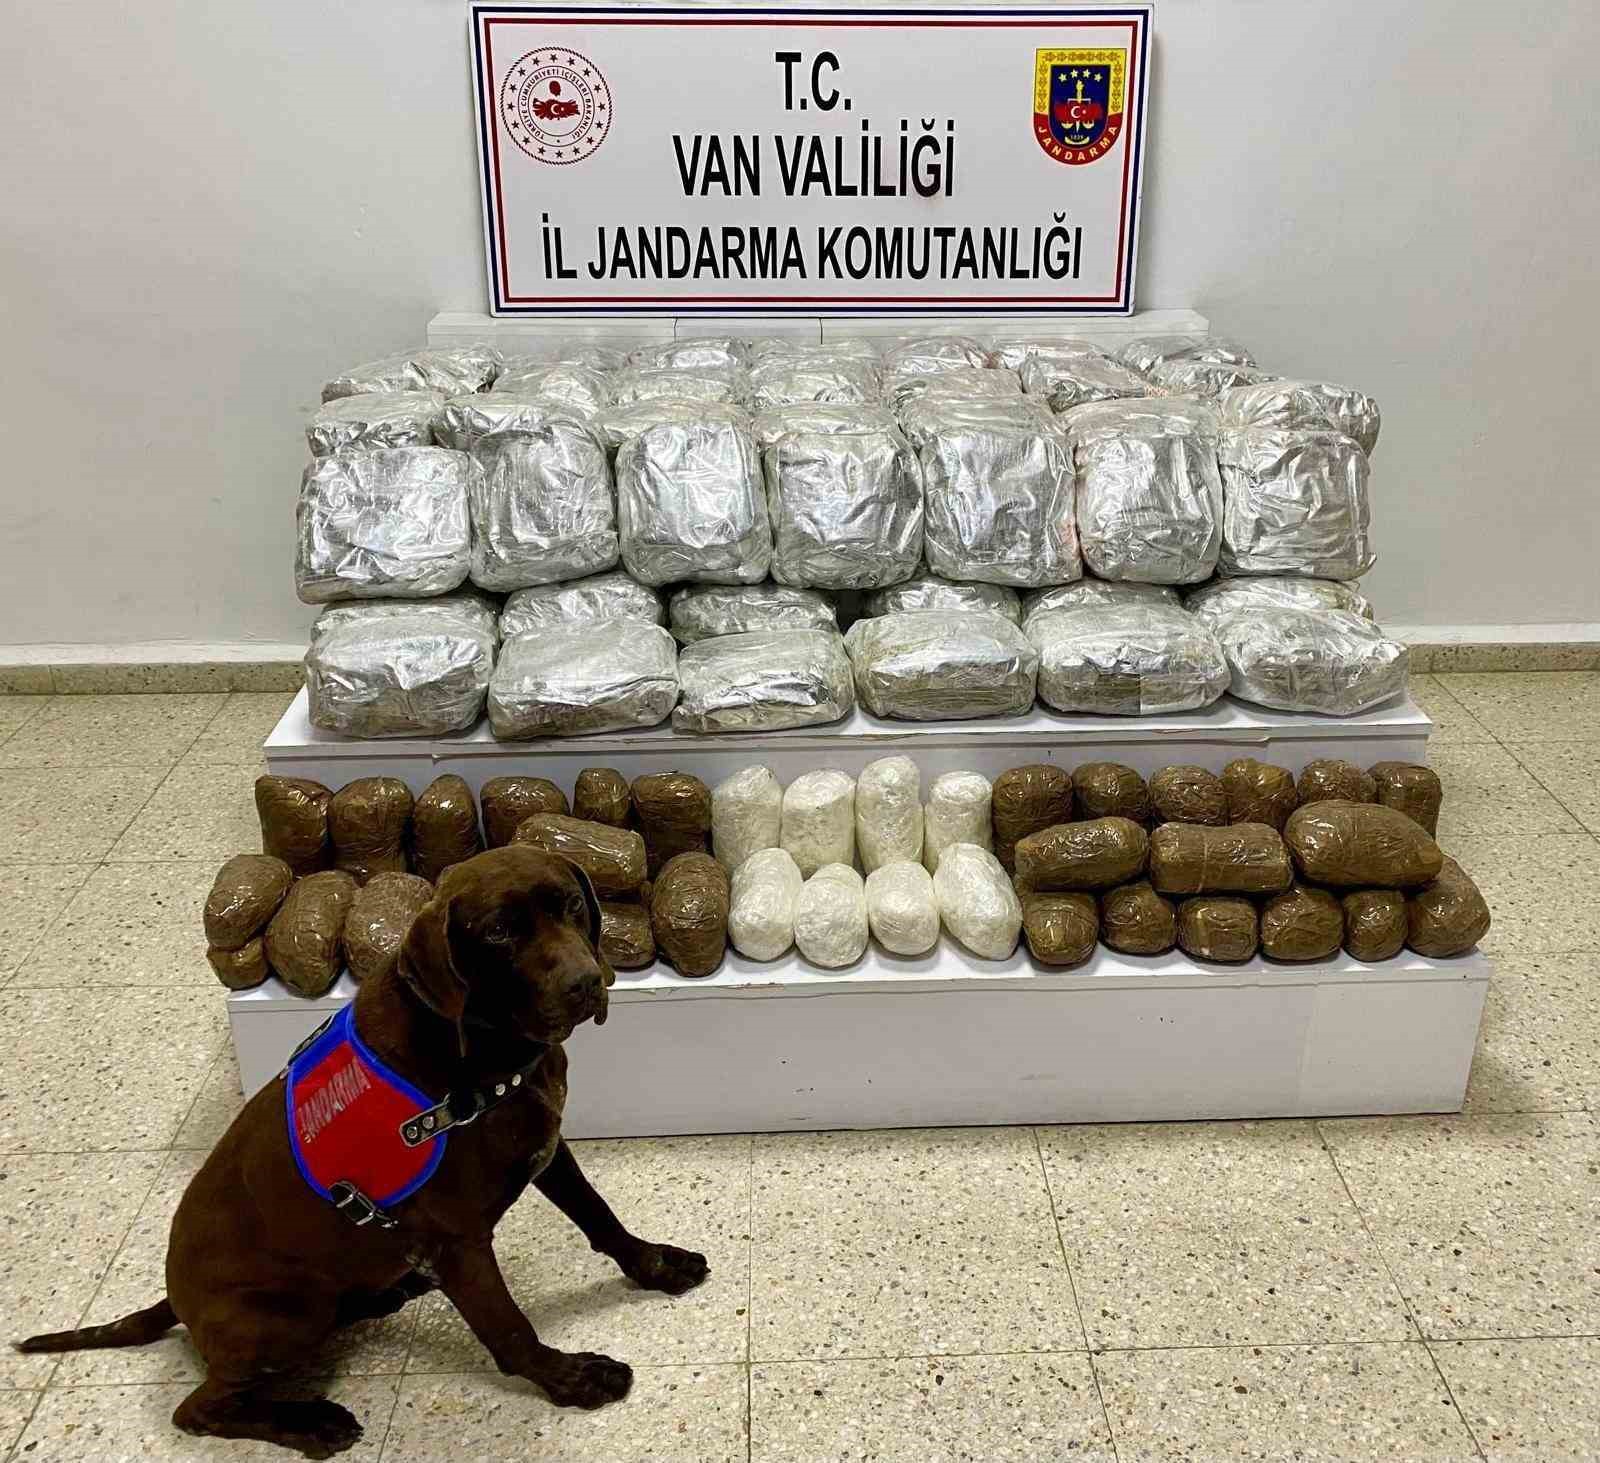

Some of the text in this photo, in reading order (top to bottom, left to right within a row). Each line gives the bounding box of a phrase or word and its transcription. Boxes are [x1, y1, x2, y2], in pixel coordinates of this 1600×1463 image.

[521, 68, 559, 107] CUMHURİYETİ
[775, 51, 852, 111] T.C.
[672, 118, 955, 198] VAN VALİLİĞİ
[1038, 126, 1118, 161] JANDARMA
[541, 211, 1082, 280] İL JANDARMA KOMUTANLIĞI
